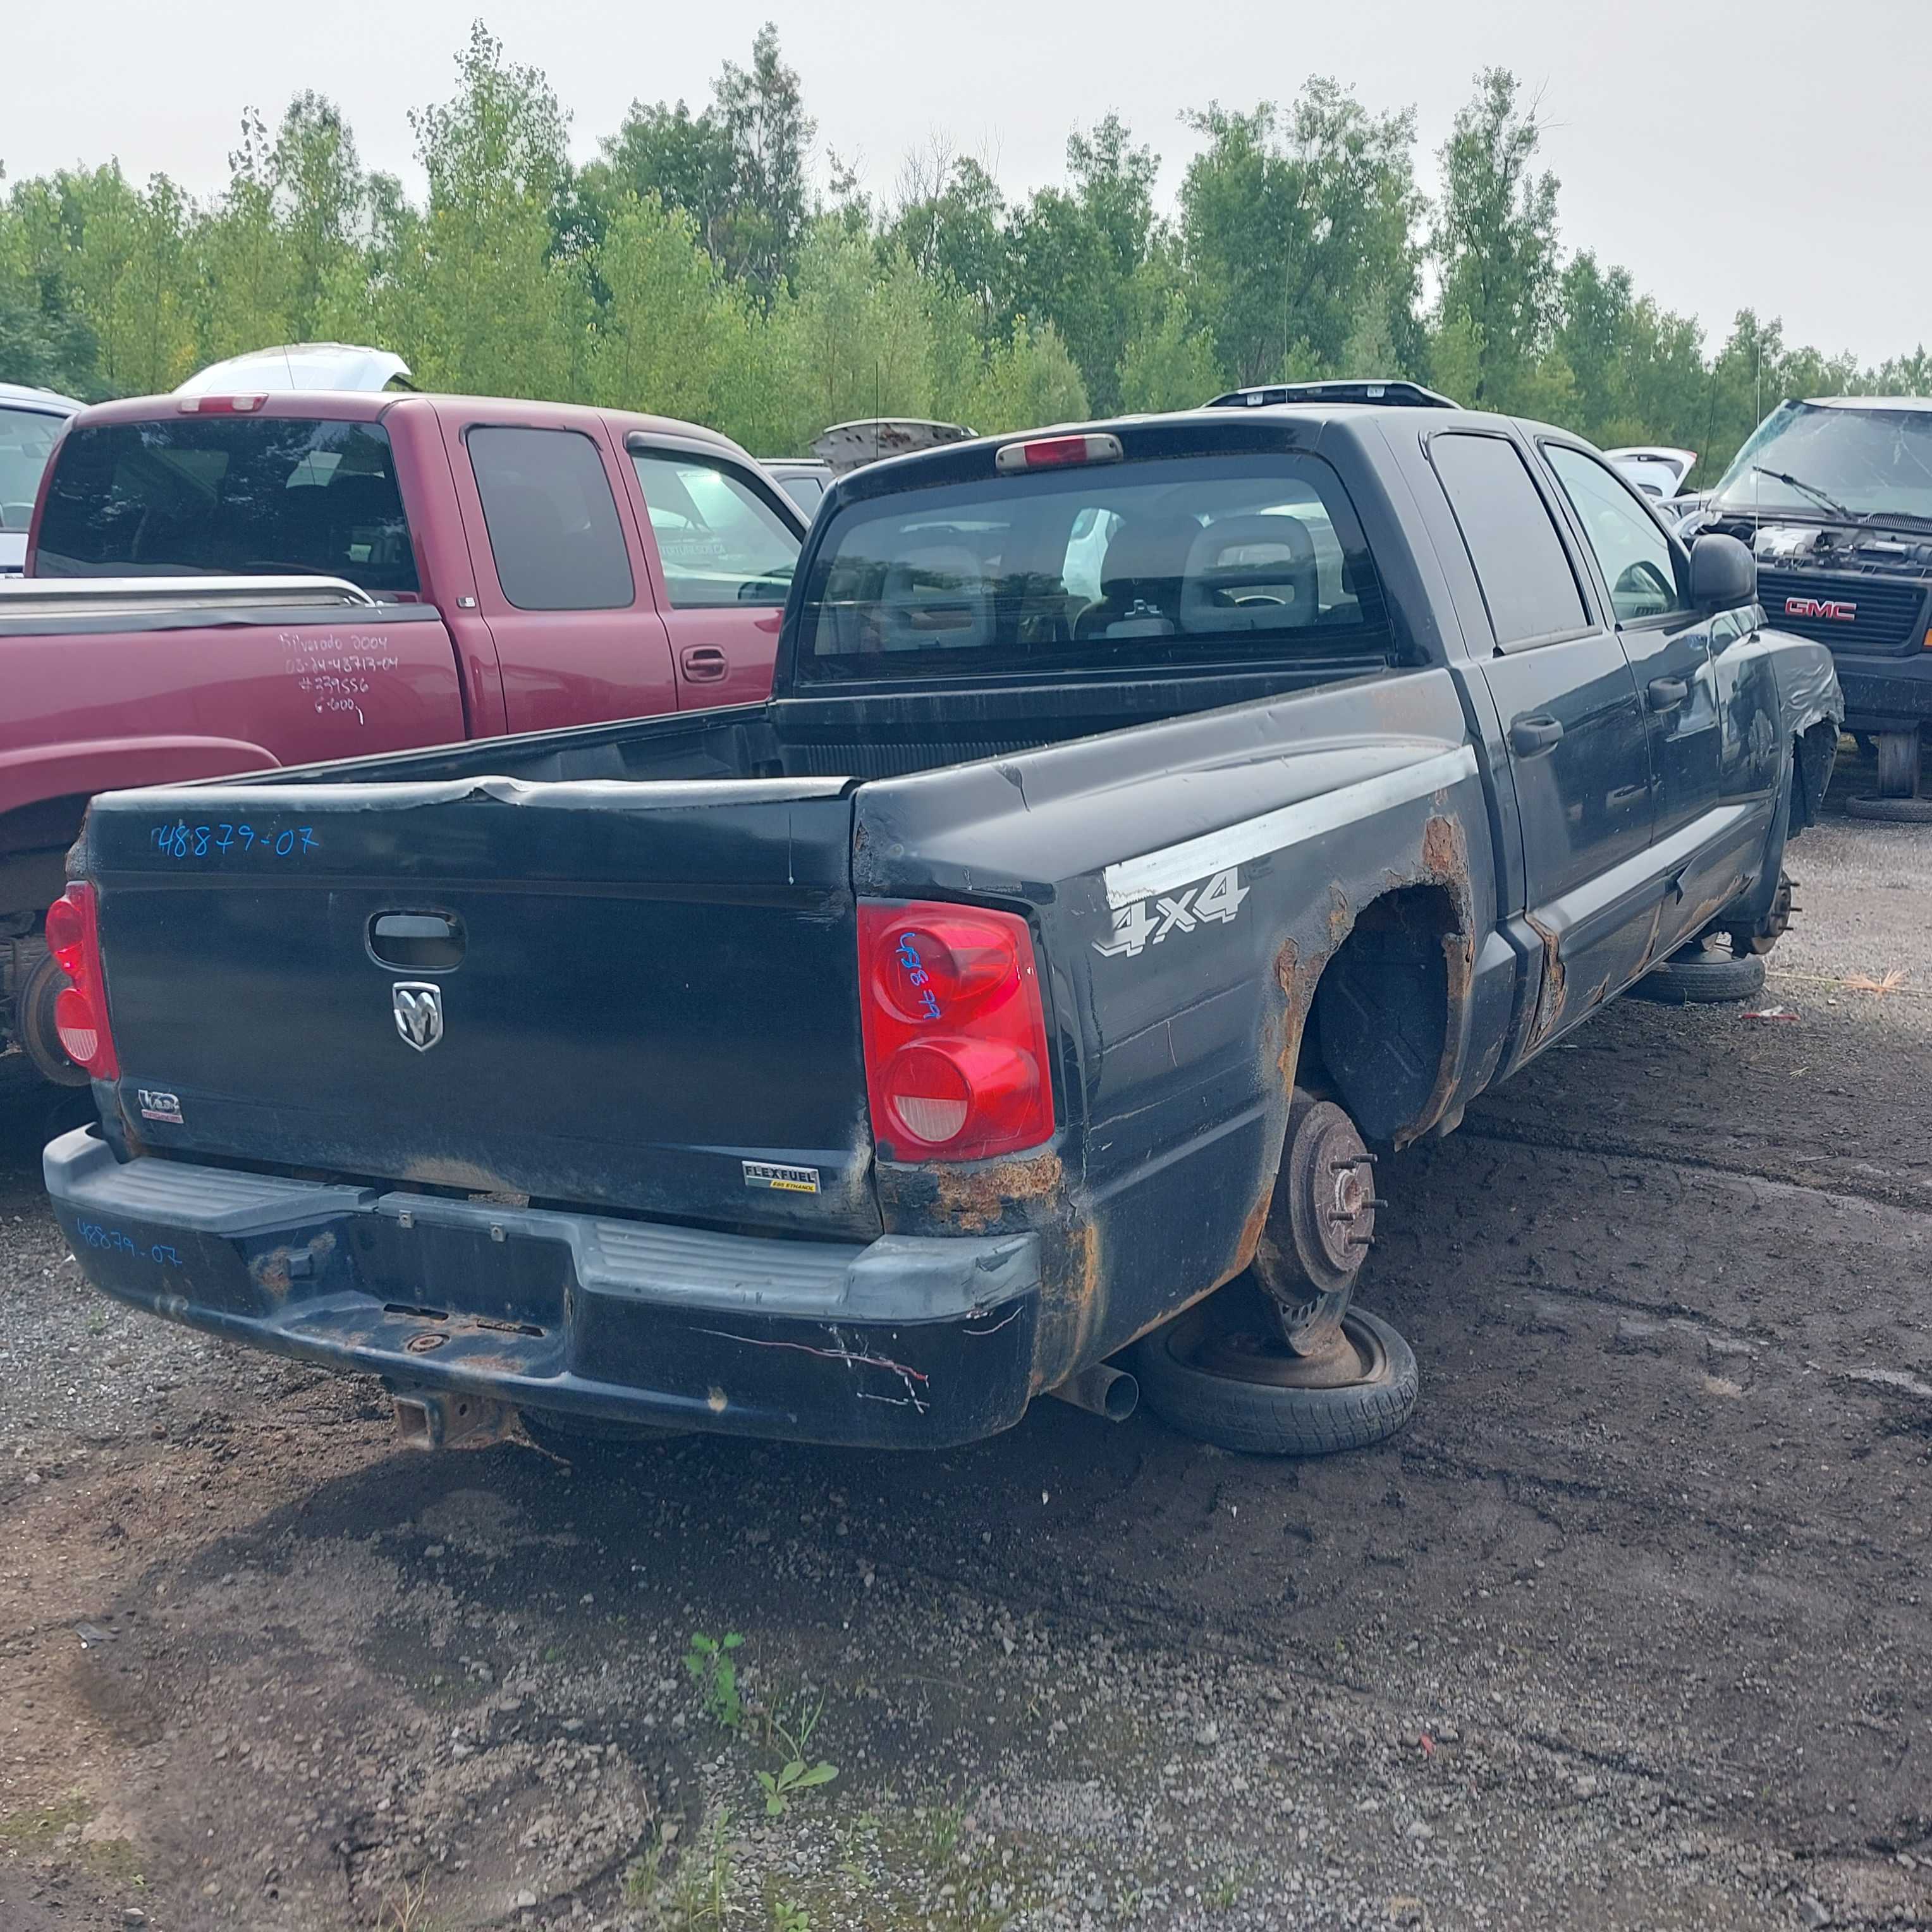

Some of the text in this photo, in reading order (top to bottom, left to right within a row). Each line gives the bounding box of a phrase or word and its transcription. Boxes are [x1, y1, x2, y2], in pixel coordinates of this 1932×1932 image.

[1785, 597, 1857, 621] GMC
[158, 823, 319, 858] 48879-07
[745, 1165, 816, 1183] FLEXFUEL
[785, 1183, 814, 1192] ETHANOL
[76, 1217, 183, 1267] 48879-07
